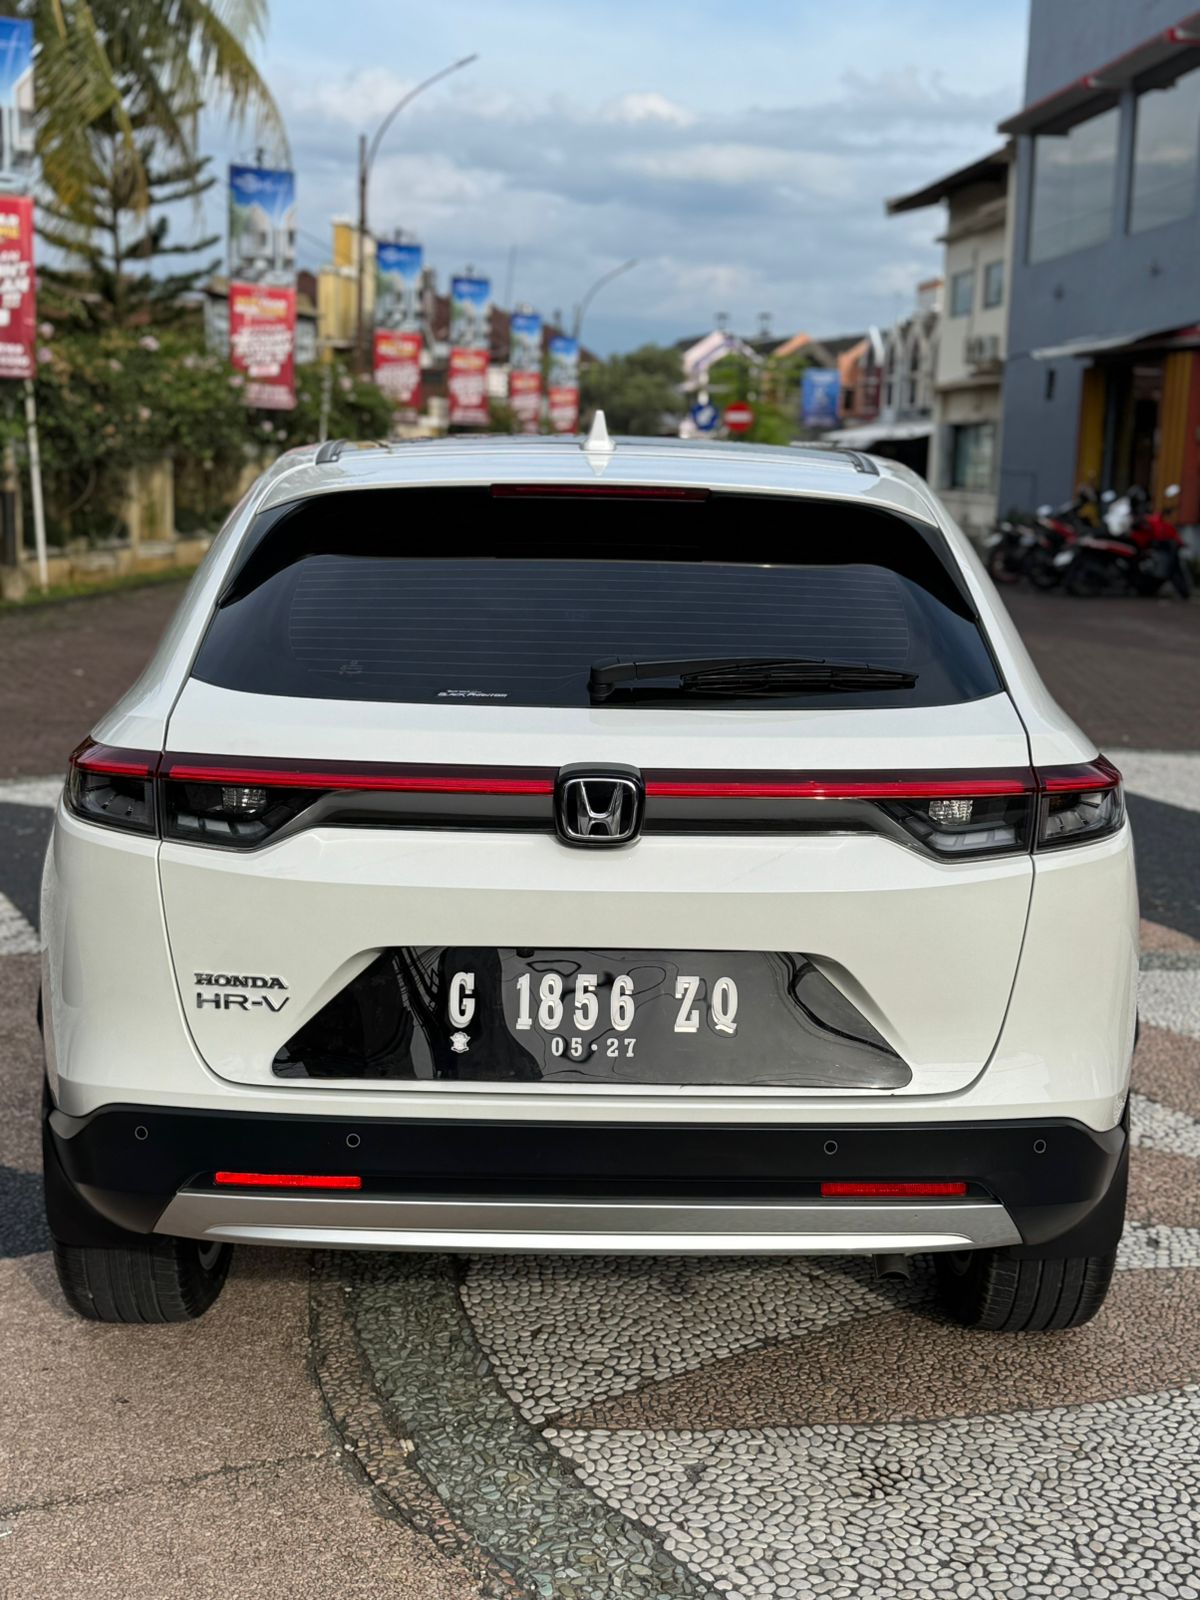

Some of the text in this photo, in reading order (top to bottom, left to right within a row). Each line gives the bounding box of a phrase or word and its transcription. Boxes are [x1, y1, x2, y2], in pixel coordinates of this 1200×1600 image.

[194, 972, 289, 990] HONDA
[196, 992, 290, 1012] HR-V
[448, 971, 739, 1034] G 1856 ZQ
